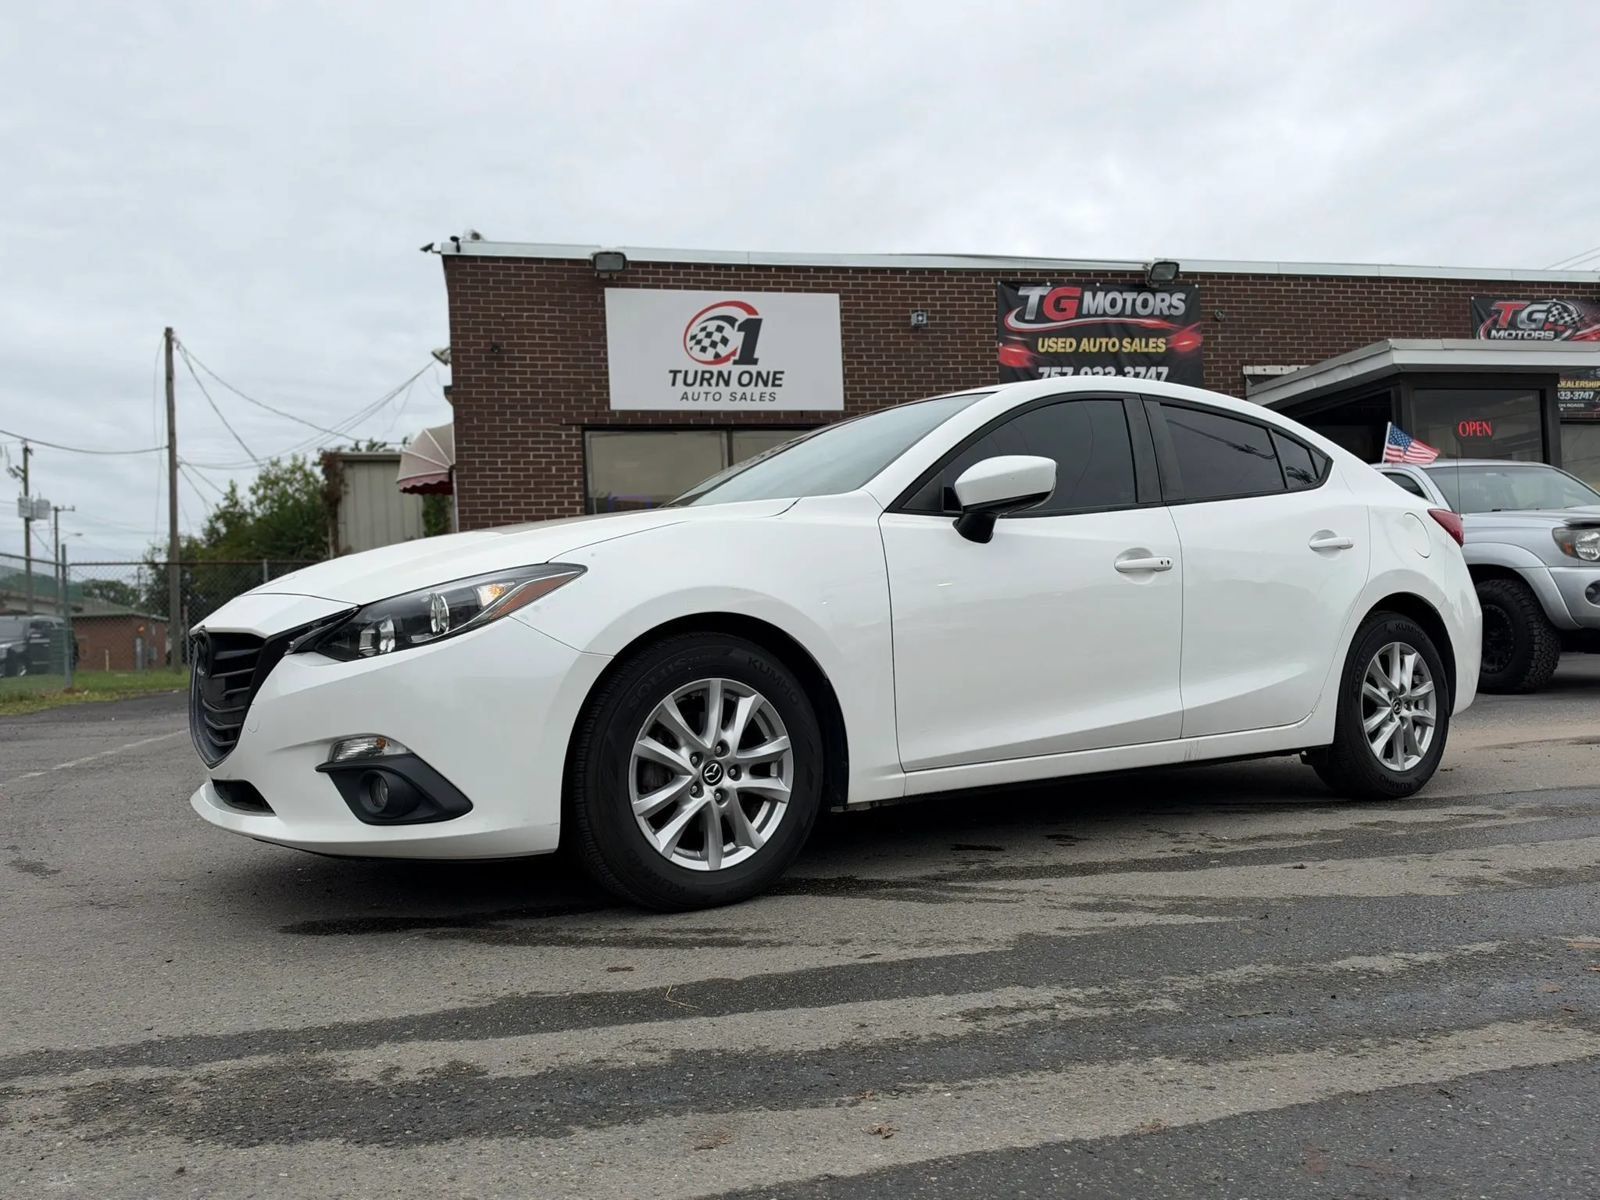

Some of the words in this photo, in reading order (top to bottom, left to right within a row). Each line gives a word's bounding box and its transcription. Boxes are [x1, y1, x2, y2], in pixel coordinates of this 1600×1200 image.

[1018, 286, 1082, 321] TG
[1082, 291, 1187, 316] MOTORS
[1491, 301, 1551, 330] TG
[1490, 329, 1555, 340] MOTORS
[1038, 337, 1076, 352] USED
[1078, 338, 1119, 352] AUTO
[1121, 338, 1167, 353] SALES
[668, 370, 732, 387] TURN
[737, 370, 785, 388] ONE
[680, 391, 722, 402] AUTO
[729, 391, 777, 402] SALES
[1558, 391, 1594, 400] 33-3747
[1458, 421, 1492, 437] OPEN
[747, 656, 800, 705] KUMHO
